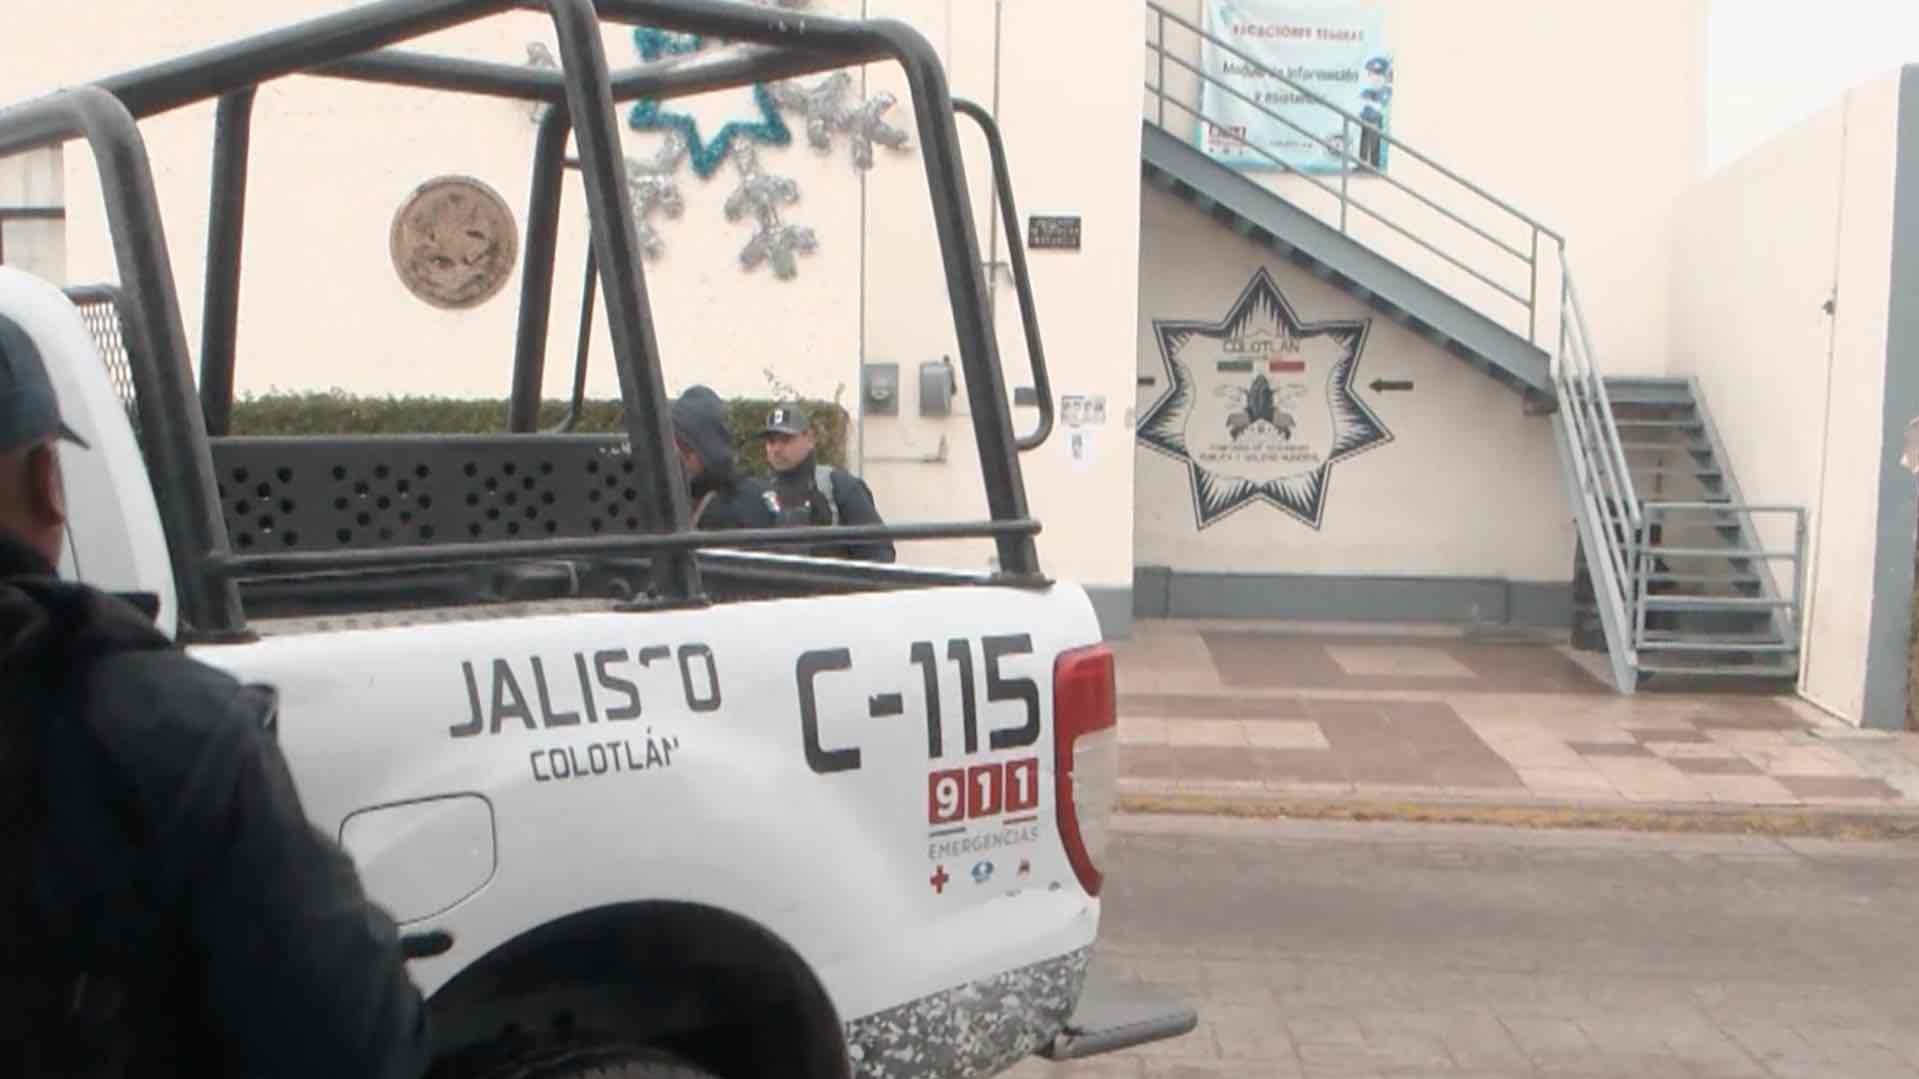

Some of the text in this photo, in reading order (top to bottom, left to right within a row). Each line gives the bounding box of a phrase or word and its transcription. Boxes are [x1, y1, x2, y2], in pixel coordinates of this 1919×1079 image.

[795, 633, 1040, 775] C-115
[934, 763, 1030, 820] 911
[928, 826, 1039, 860] EMERGENCIAS
